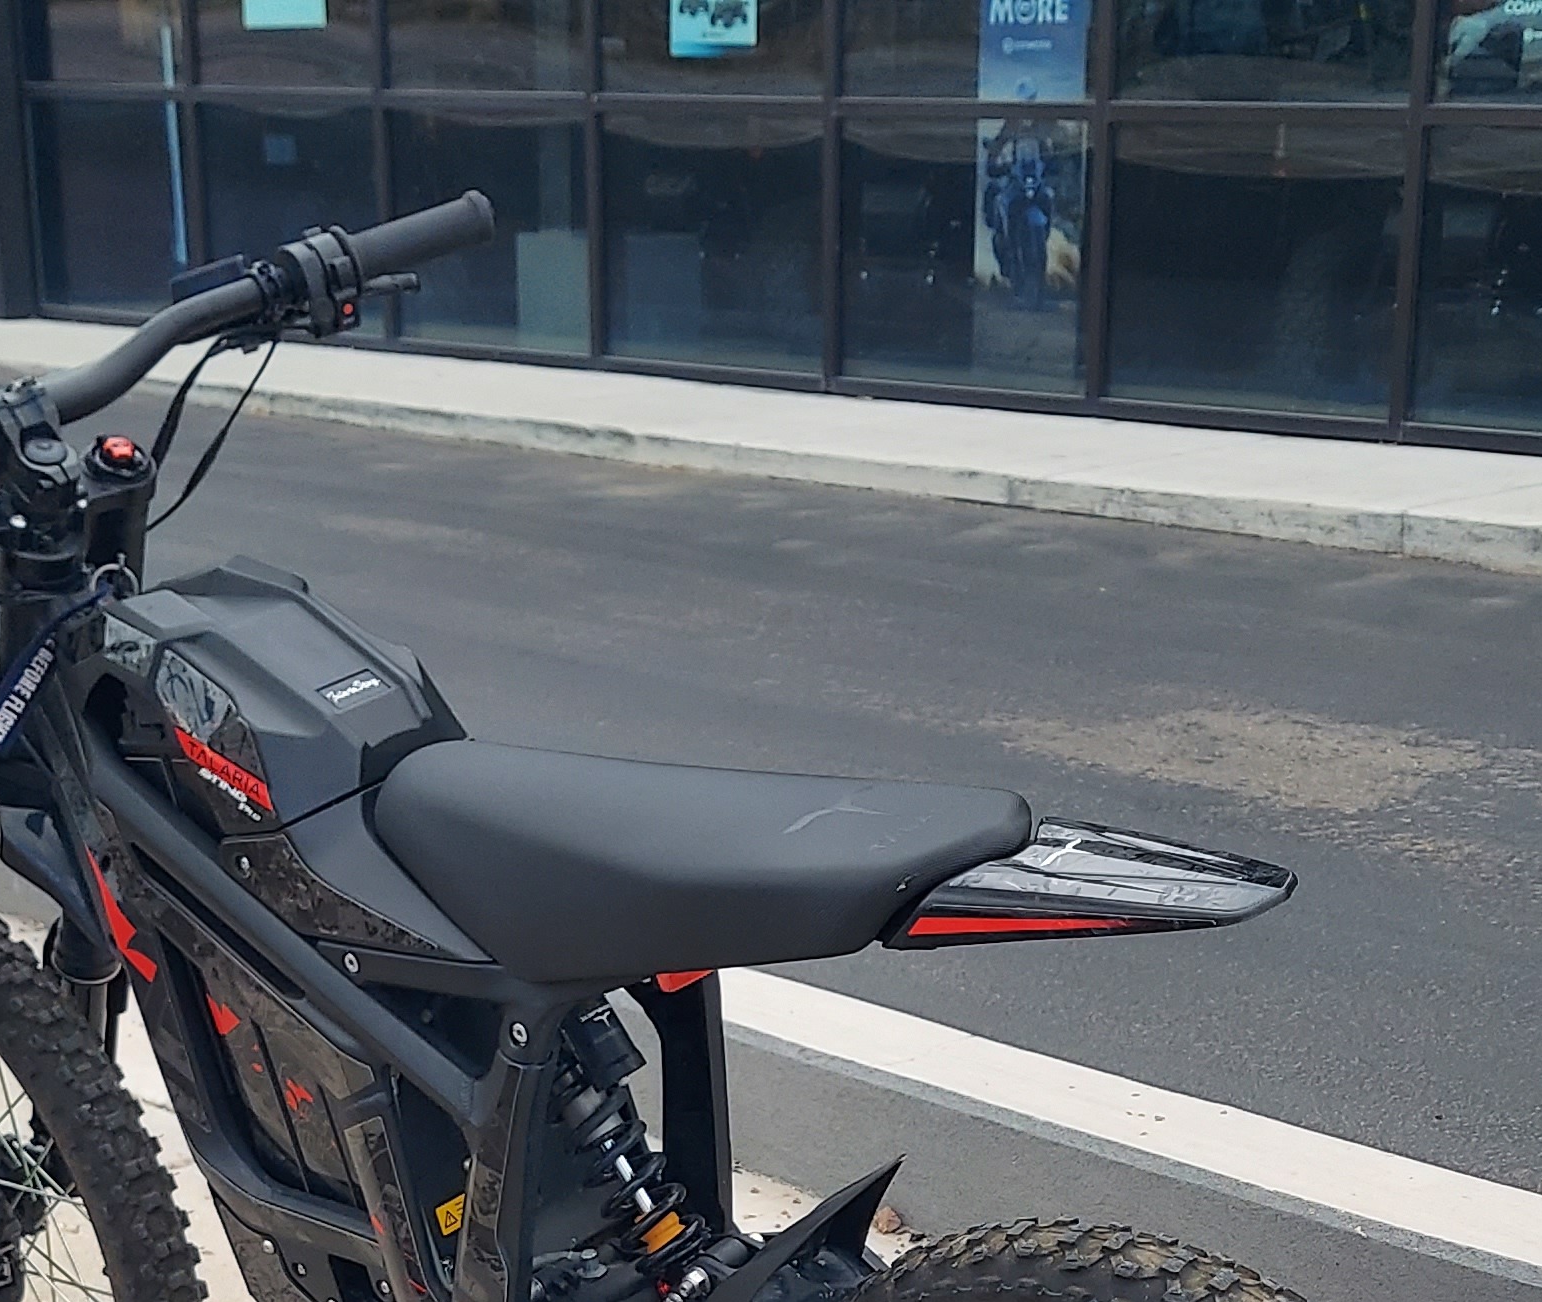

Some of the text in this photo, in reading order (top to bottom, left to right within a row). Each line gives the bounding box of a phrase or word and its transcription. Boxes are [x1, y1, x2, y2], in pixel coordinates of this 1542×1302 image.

[989, 0, 1069, 25] MORE
[13, 646, 55, 700] BEFORE
[187, 740, 262, 800] TALARIA
[197, 766, 248, 803] STING
